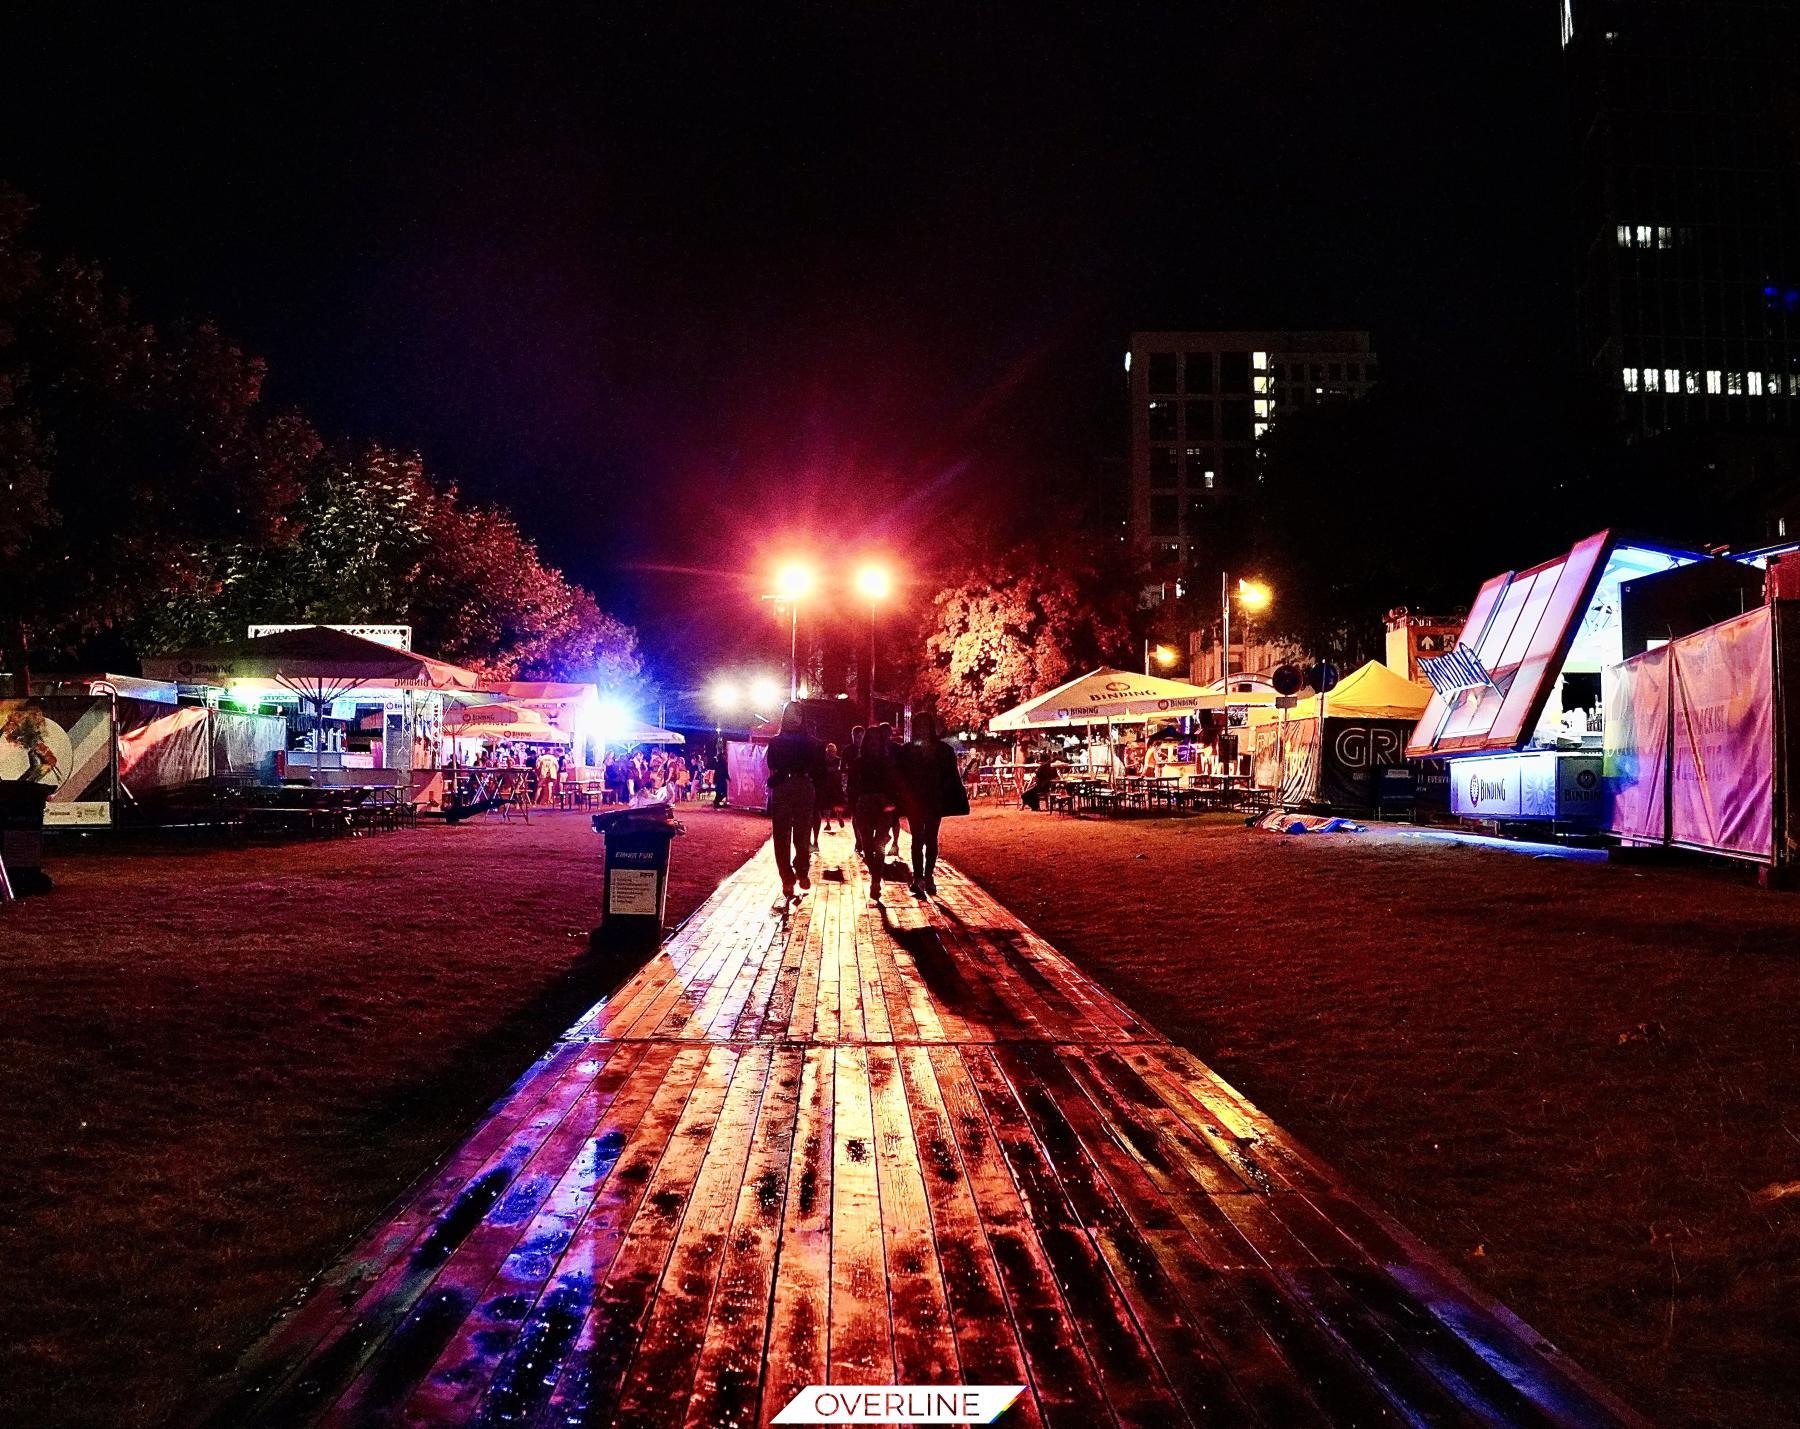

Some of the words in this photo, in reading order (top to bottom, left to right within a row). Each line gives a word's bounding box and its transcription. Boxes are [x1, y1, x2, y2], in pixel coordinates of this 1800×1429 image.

[194, 662, 235, 674] BINDING
[1089, 689, 1157, 702] BINDING
[1170, 698, 1198, 708] BINDING
[472, 713, 495, 721] BINDING
[1070, 706, 1099, 716] BINDING
[1480, 778, 1506, 802] BINDING
[1564, 788, 1601, 802] BINDIN
